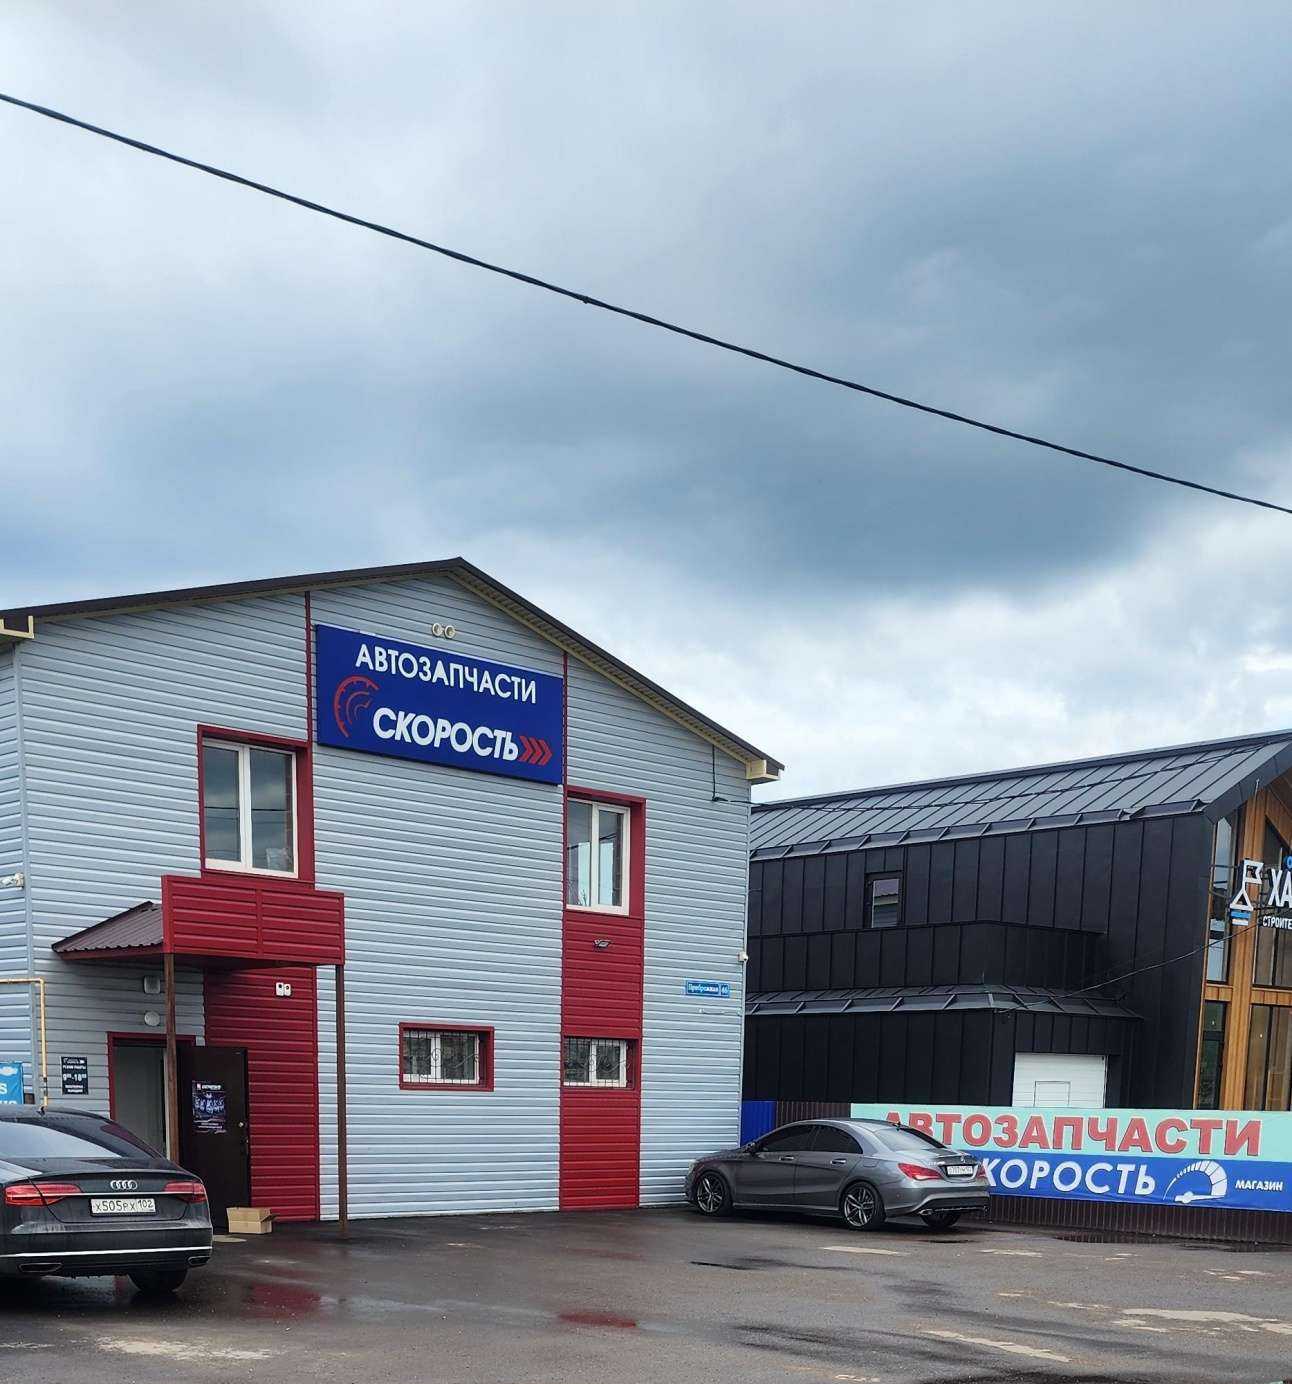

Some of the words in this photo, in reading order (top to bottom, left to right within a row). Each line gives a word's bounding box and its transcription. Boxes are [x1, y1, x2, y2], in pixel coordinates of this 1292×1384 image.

[355, 643, 537, 704] АВТОЗАПЧАСТИ
[373, 707, 520, 761] СКОРОСТЬ
[982, 1157, 1156, 1195] КОРОСТЬ
[1235, 1179, 1284, 1191] МАГАЗИН
